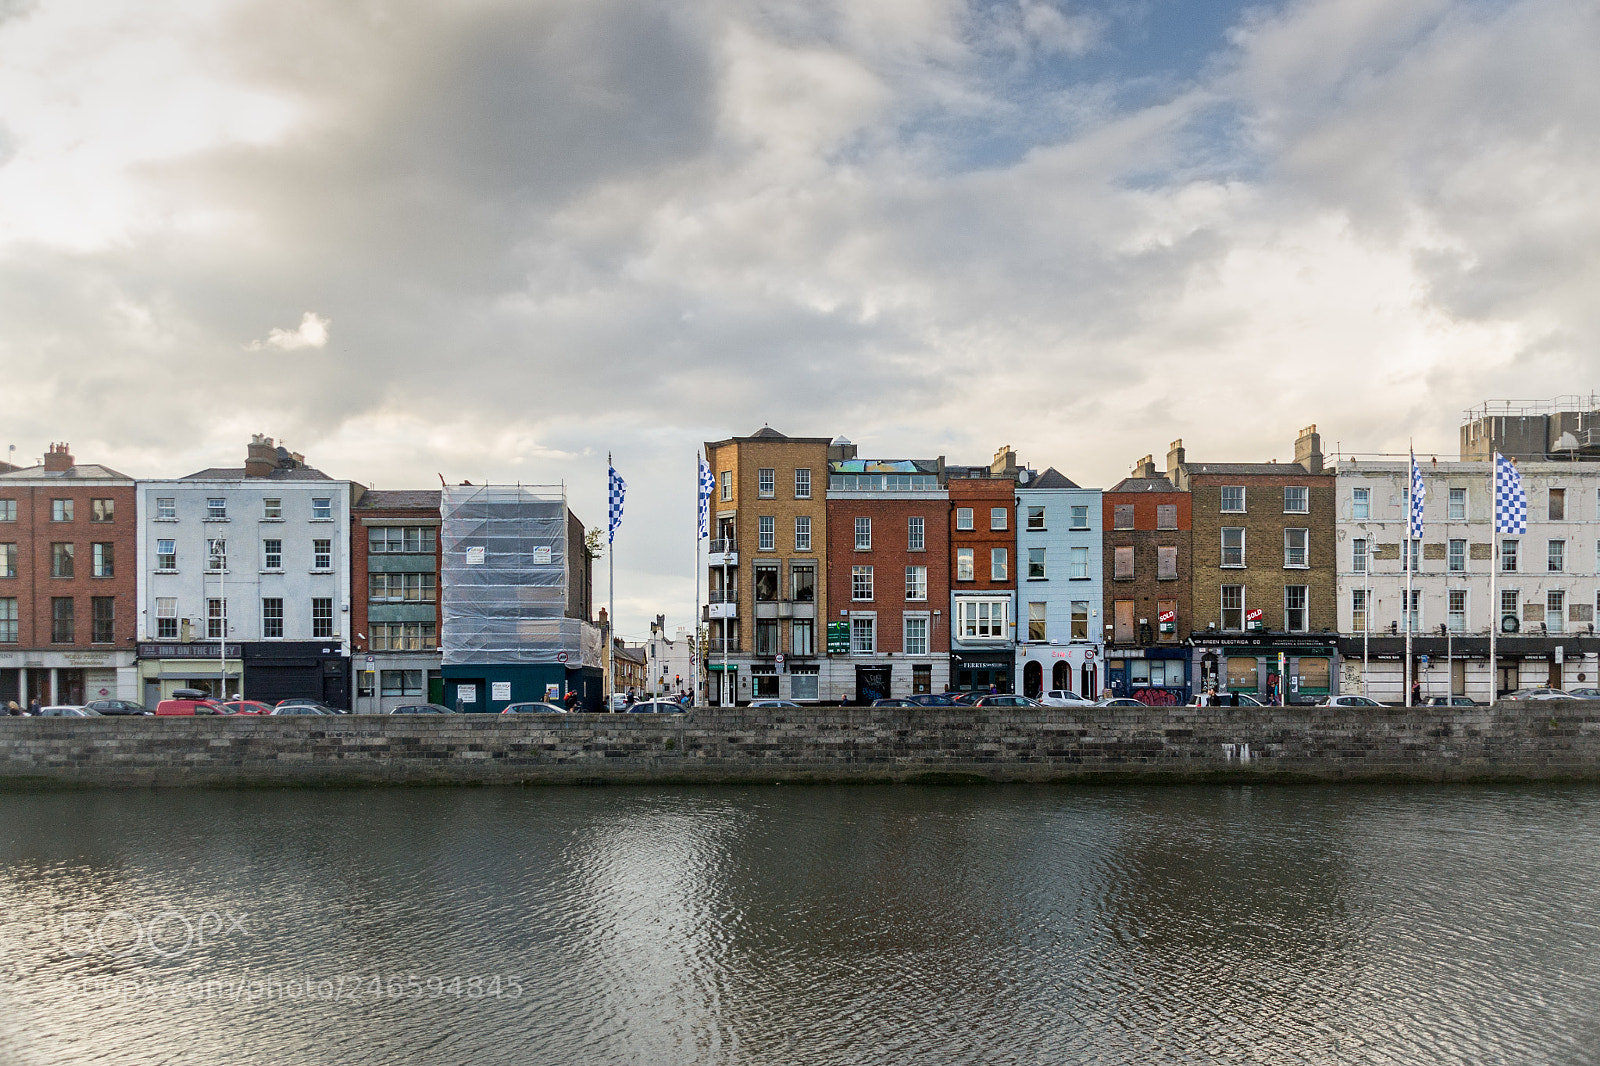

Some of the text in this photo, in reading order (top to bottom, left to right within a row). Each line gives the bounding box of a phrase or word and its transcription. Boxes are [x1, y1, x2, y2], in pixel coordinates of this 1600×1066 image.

[1160, 610, 1174, 622] SOLD
[1246, 609, 1263, 621] SOLD
[159, 646, 175, 655] INN
[177, 646, 190, 655] ON
[193, 646, 207, 655] THE
[209, 646, 235, 655] LIFEY
